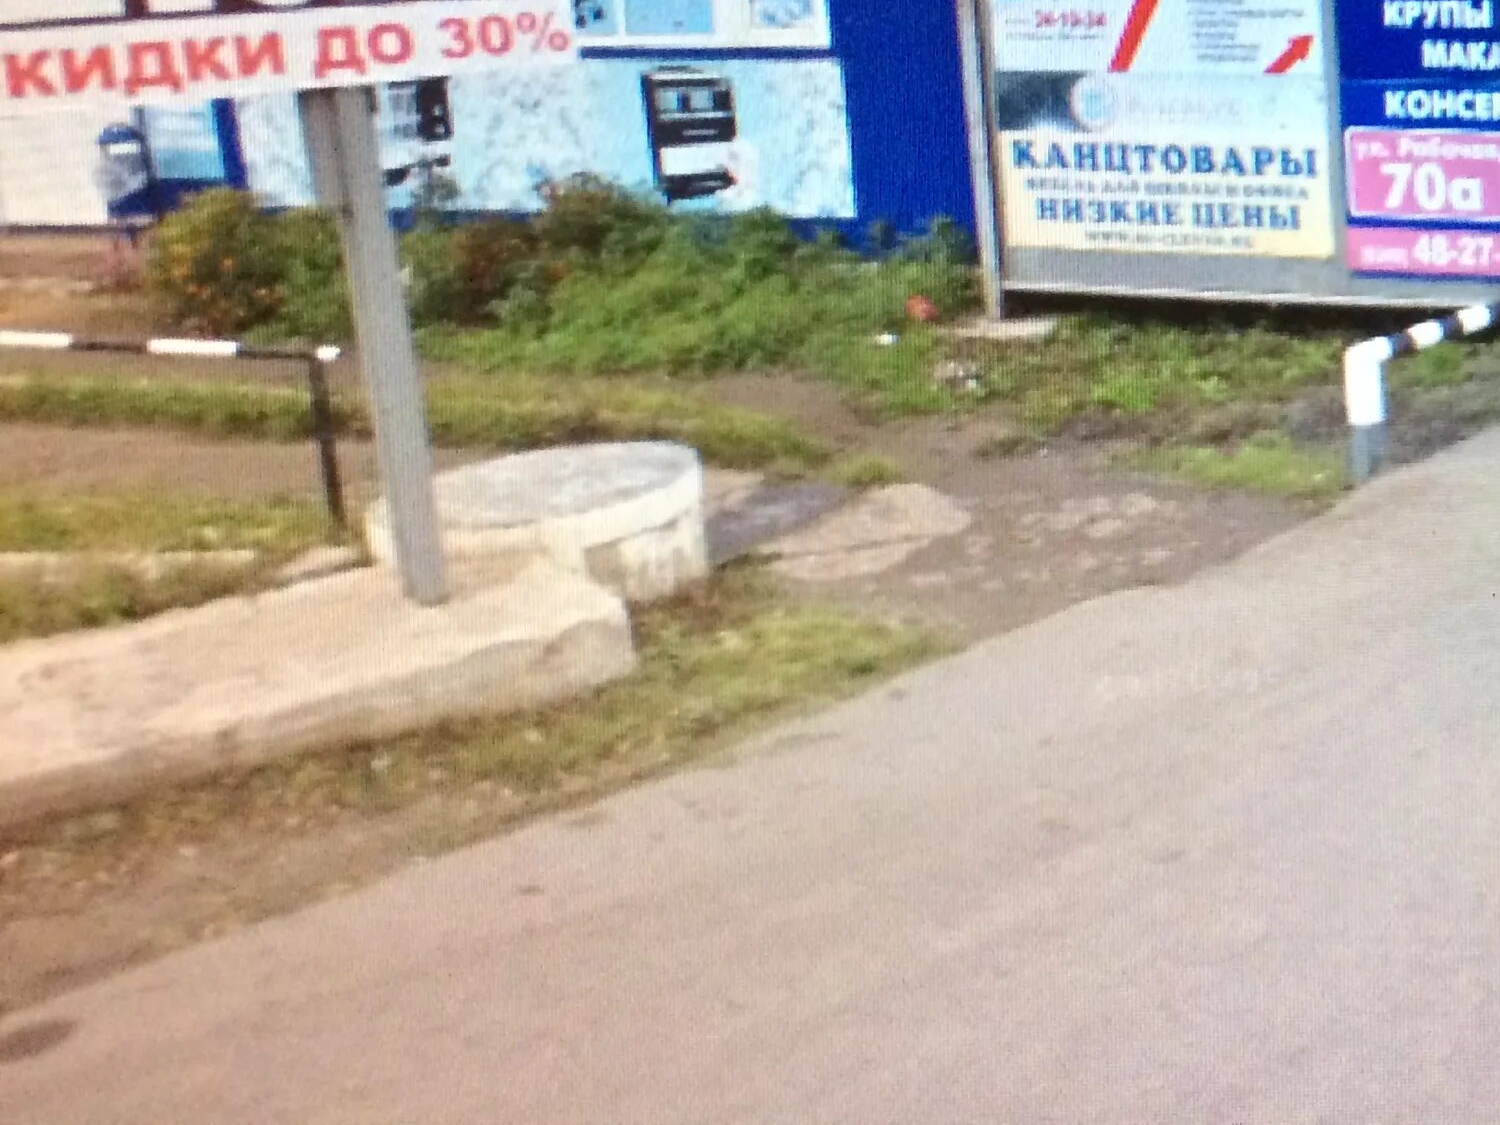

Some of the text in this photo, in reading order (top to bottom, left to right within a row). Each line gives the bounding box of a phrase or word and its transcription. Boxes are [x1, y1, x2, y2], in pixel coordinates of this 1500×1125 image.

[3, 12, 571, 99] КИДКИ ДО 30%
[1010, 138, 1319, 179] КАНЦТОВАРЫ
[1379, 161, 1484, 211] 70а
[1035, 196, 1302, 232] НИЗКИЕ ЦЕНЫ
